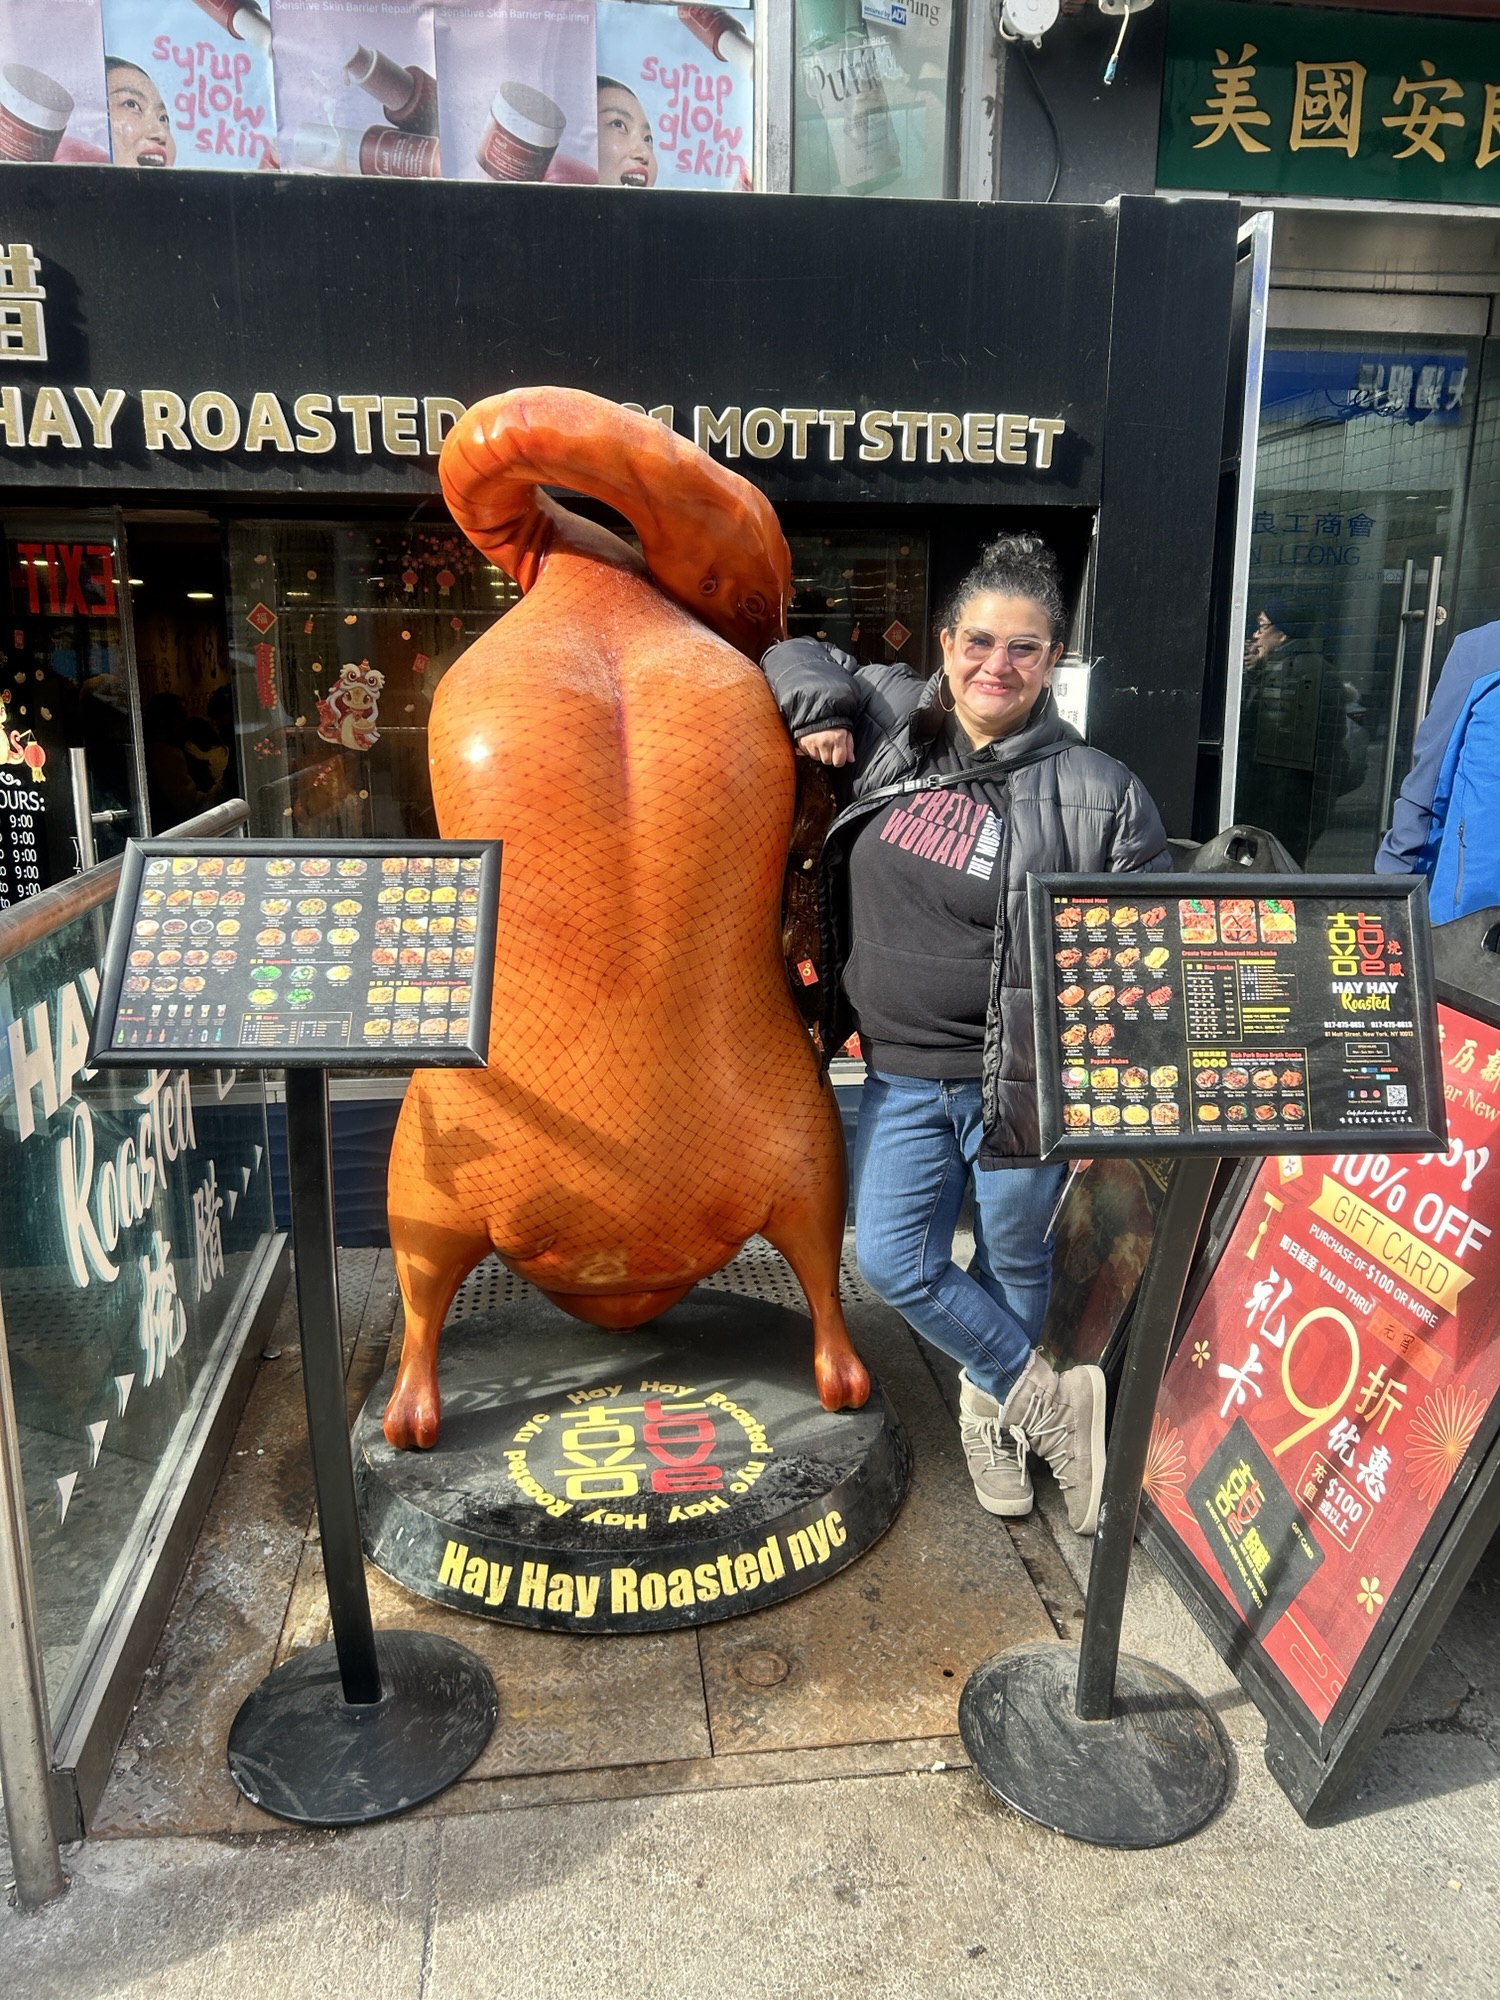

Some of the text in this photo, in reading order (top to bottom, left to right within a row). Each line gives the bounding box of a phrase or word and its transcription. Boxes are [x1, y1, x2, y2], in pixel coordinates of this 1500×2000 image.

[322, 2, 344, 12] Skin
[346, 3, 378, 13] Barrier
[381, 3, 428, 16] Repairing
[439, 6, 590, 24] Sensitive Skin Barrier Repairing
[893, 9, 906, 24] ADT
[152, 35, 251, 93] syrup
[173, 75, 265, 130] glow
[640, 56, 733, 116] syrup
[195, 118, 270, 157] skin
[659, 96, 742, 150] glow
[675, 139, 746, 177] skin
[141, 390, 469, 456] ROASTED
[694, 405, 856, 461] MOTT
[859, 409, 1066, 469] STREET
[1279, 543, 1361, 567] LEONG
[10, 814, 33, 828] 9:00
[907, 789, 989, 836] PRETTY
[11, 831, 35, 845] 9:00
[13, 849, 37, 863] 9:00
[879, 808, 975, 871] WOMAN
[15, 866, 39, 879] 9:00
[966, 854, 994, 881] THE
[17, 882, 41, 897] 9:00
[1332, 982, 1398, 994] HAY HAY
[1341, 991, 1391, 1012] Roasted
[1462, 1087, 1500, 1123] New
[57, 1068, 197, 1289] Roasted
[1333, 1196, 1449, 1294] GIFT CARD
[1413, 1192, 1492, 1259] OFF
[1280, 1234, 1373, 1315] 即日起至 VALID THRU
[1309, 1223, 1438, 1328] PURCHASE OF $100 OR MORE
[1272, 1306, 1408, 1458] 9 折
[567, 1380, 773, 1493] Hay Hay Roasted nyc
[503, 1413, 730, 1530] Hay Hay Roasted nyc
[1327, 1416, 1392, 1503] 优惠
[1302, 1462, 1328, 1502] 充值
[1324, 1478, 1363, 1523] $100
[1318, 1498, 1349, 1538] 或以上
[1208, 1506, 1220, 1523] MOTT
[1236, 1561, 1247, 1582] YORK,
[1251, 1588, 1263, 1609] 10013
[1291, 1522, 1314, 1560] GIFT CARD
[437, 1510, 848, 1618] Hay Hay Roasted nyc
[1251, 1568, 1268, 1597] ROASTED
